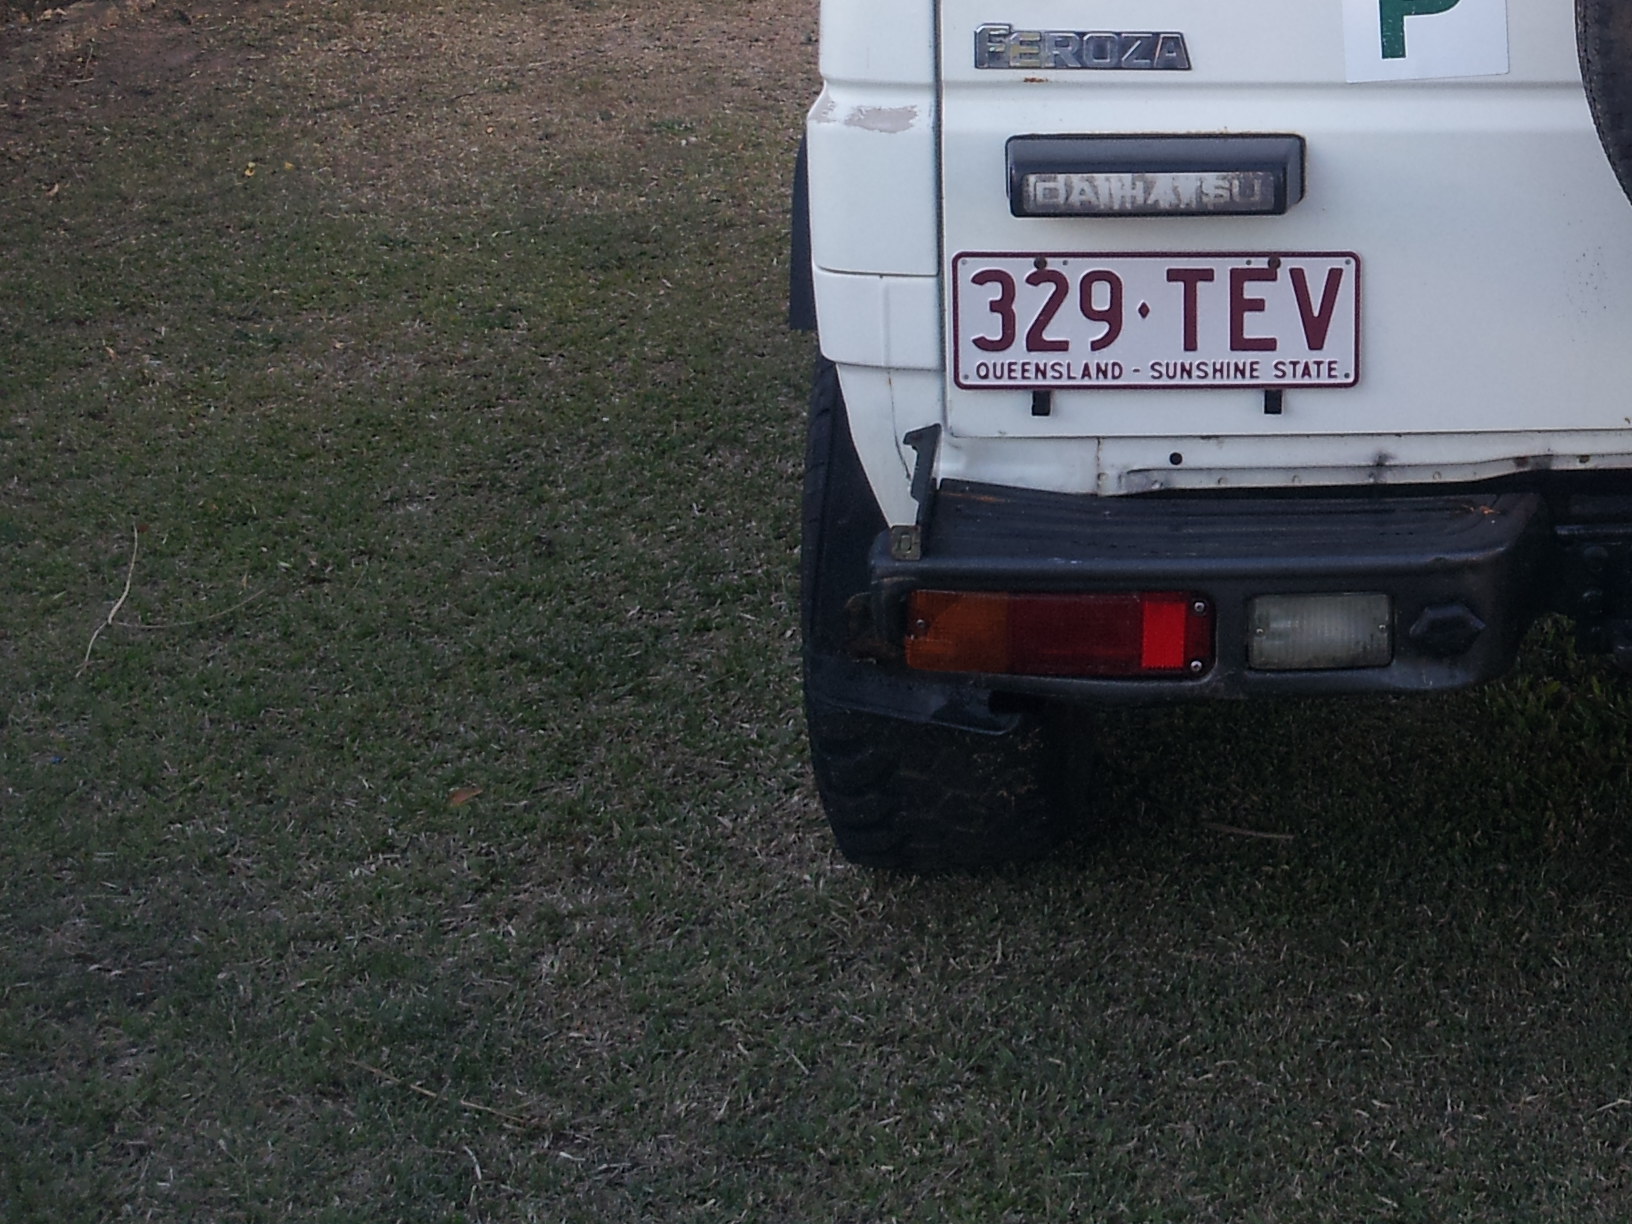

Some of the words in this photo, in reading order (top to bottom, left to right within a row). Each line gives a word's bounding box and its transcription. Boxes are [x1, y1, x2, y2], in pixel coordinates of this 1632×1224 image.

[974, 23, 1192, 70] FEROZA
[975, 360, 1124, 381] QUEENSLAND
[1149, 360, 1261, 380] SUNSHINE
[1273, 359, 1338, 380] STATE
